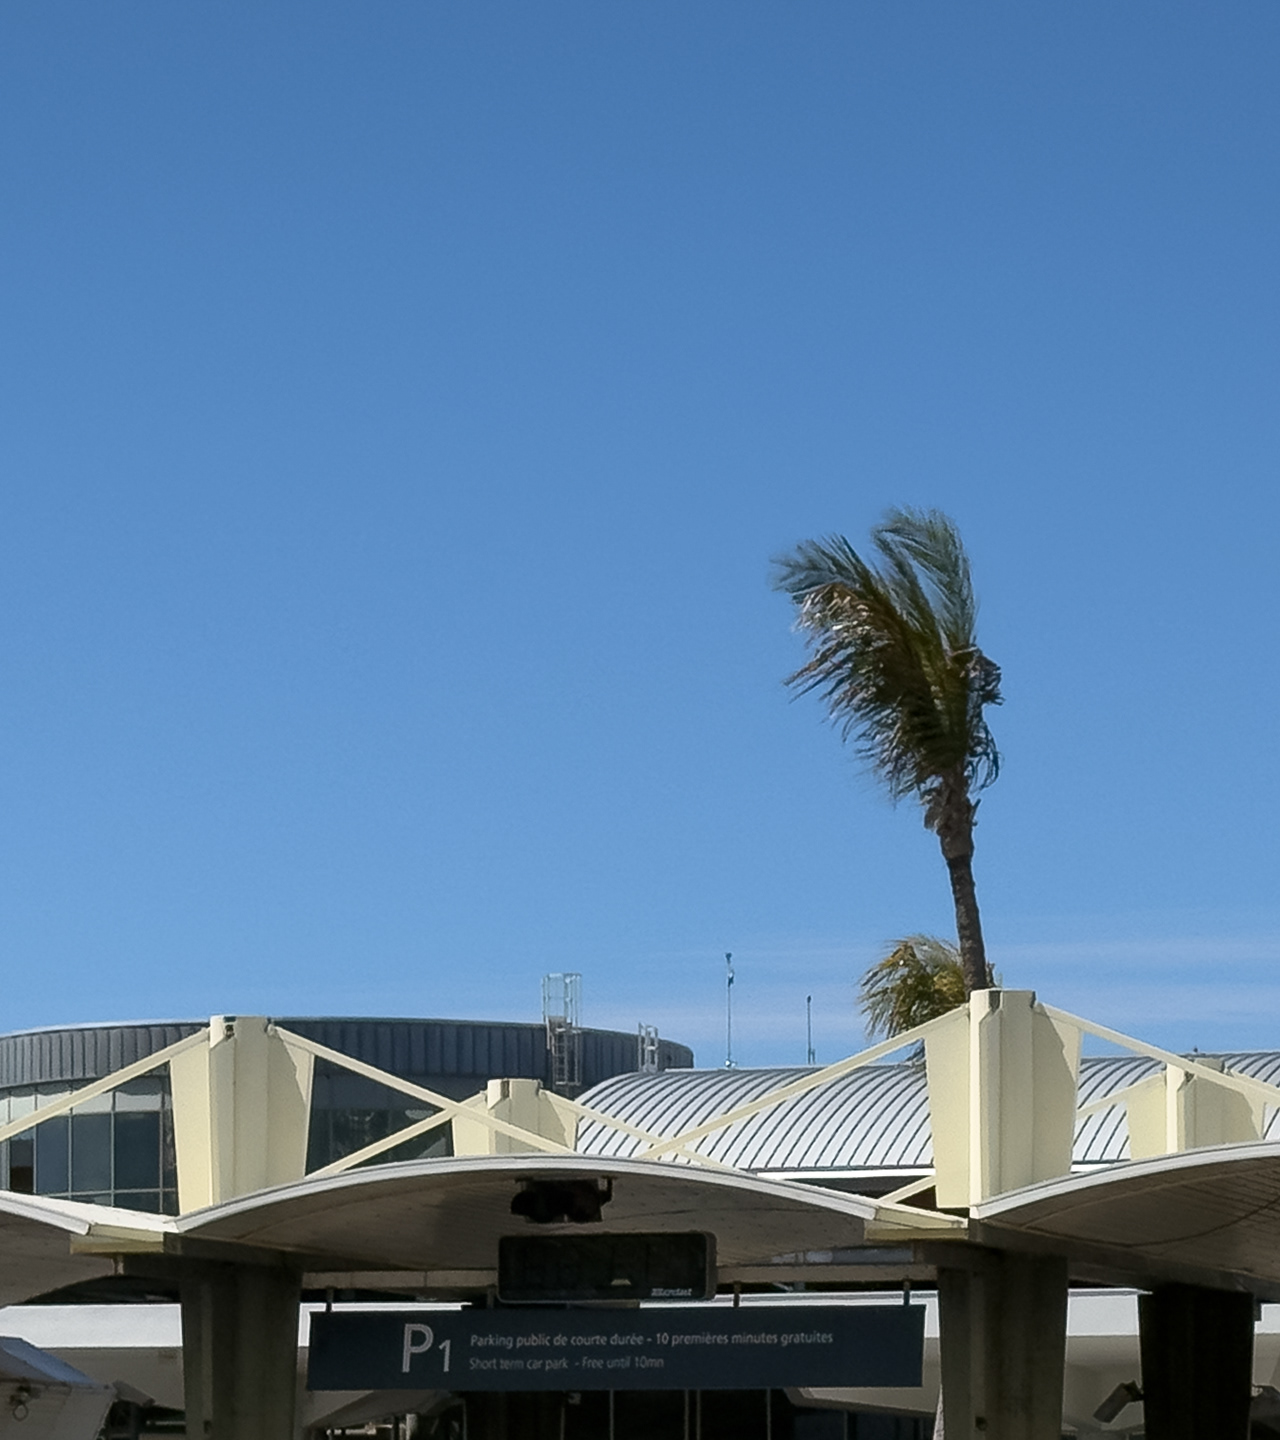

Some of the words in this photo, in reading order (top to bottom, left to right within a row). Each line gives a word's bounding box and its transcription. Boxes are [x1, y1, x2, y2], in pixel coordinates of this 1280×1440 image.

[402, 1323, 452, 1373] P1
[469, 1334, 514, 1350] Parking
[516, 1333, 551, 1349] public
[553, 1333, 568, 1346] de
[570, 1335, 607, 1347] courte
[609, 1332, 644, 1346] durée
[656, 1333, 670, 1345] 10
[671, 1331, 730, 1348] premières
[730, 1331, 778, 1345] minutes
[780, 1330, 834, 1347] gratuites
[468, 1357, 497, 1370] Short
[499, 1358, 524, 1370] term
[526, 1359, 543, 1370] car
[544, 1357, 569, 1372] park
[582, 1357, 605, 1369] Free
[606, 1356, 631, 1368] until
[633, 1356, 665, 1368] 10mn
